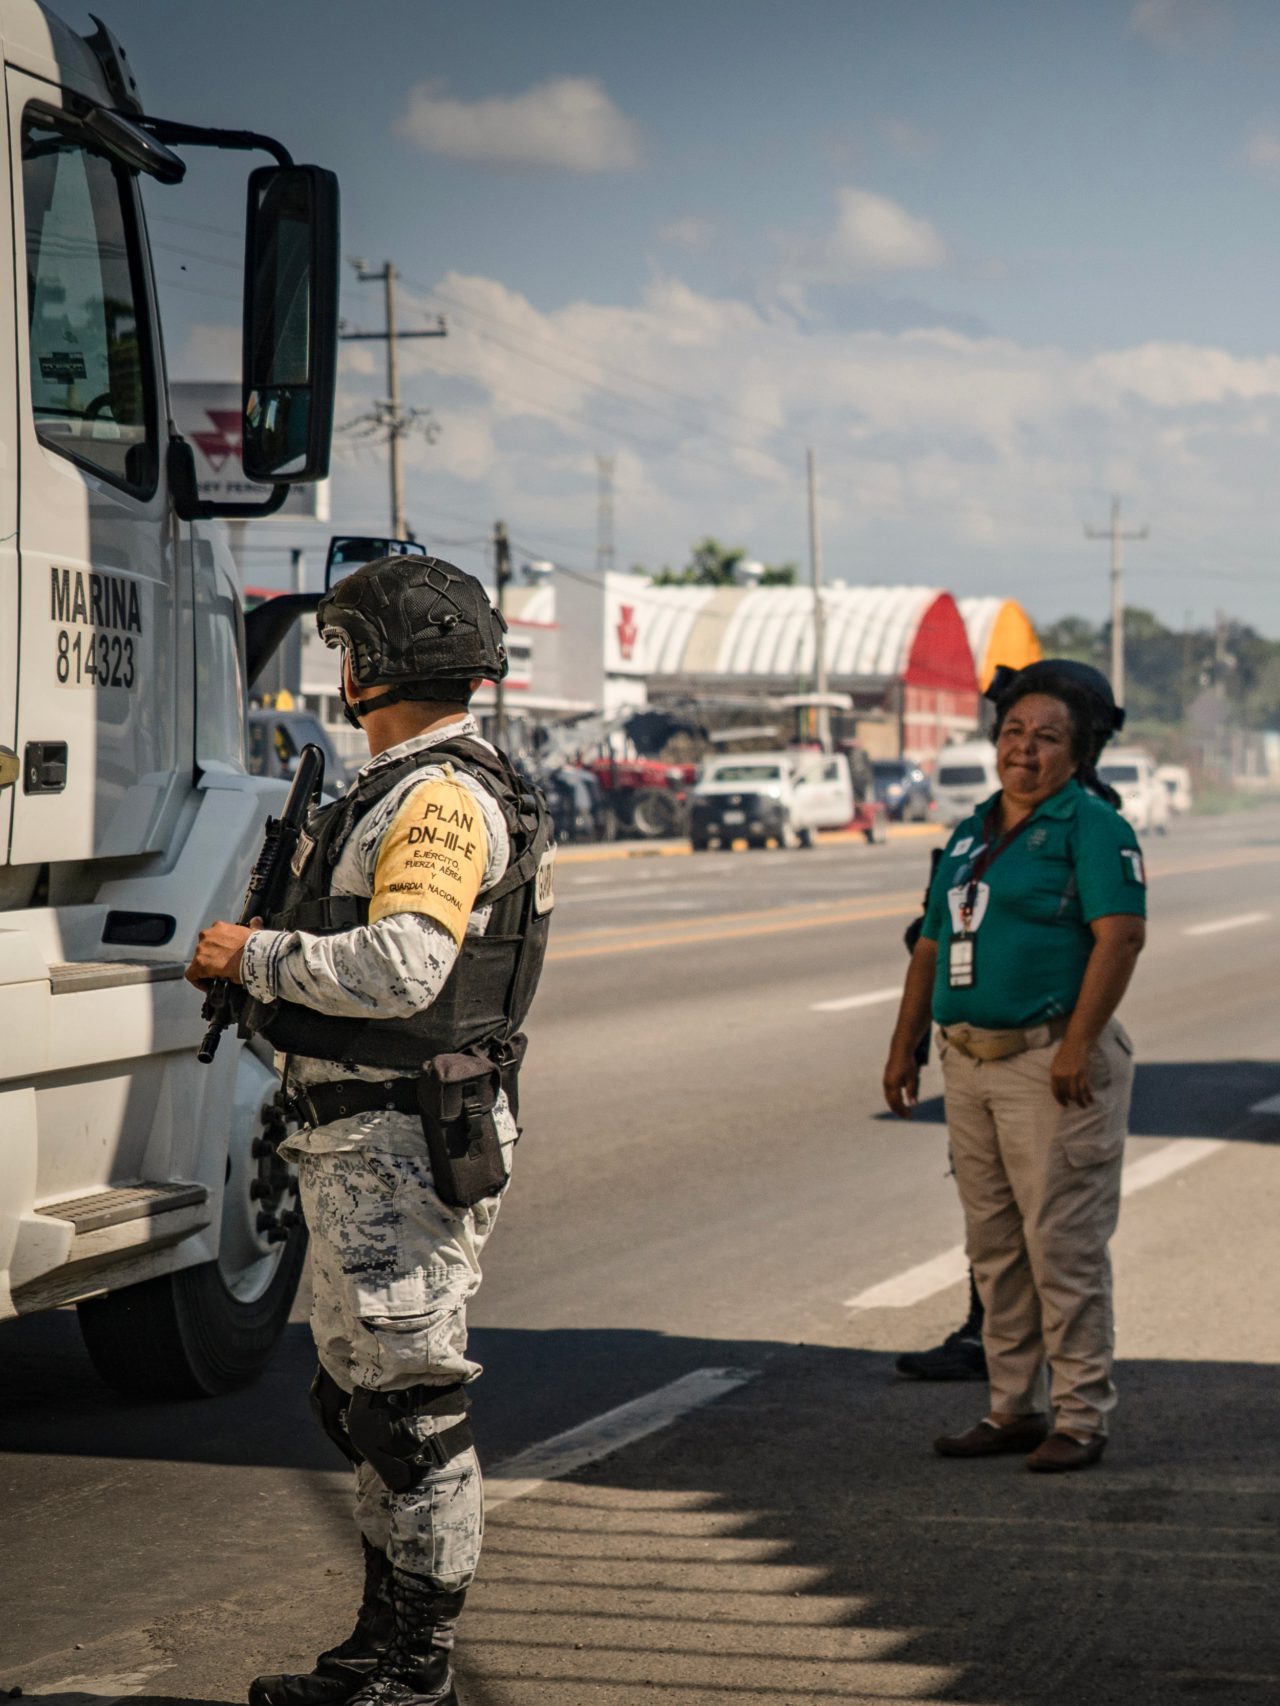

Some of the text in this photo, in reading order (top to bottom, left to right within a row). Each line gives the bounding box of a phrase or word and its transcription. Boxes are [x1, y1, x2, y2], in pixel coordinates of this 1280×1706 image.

[51, 567, 142, 633] MARINA
[57, 630, 135, 689] 814323
[423, 803, 474, 832] PLAN
[408, 826, 477, 861] DN-III-E
[405, 860, 462, 883] FUERZA AÉREA
[431, 872, 437, 880] Y
[389, 882, 424, 893] GUARDIA
